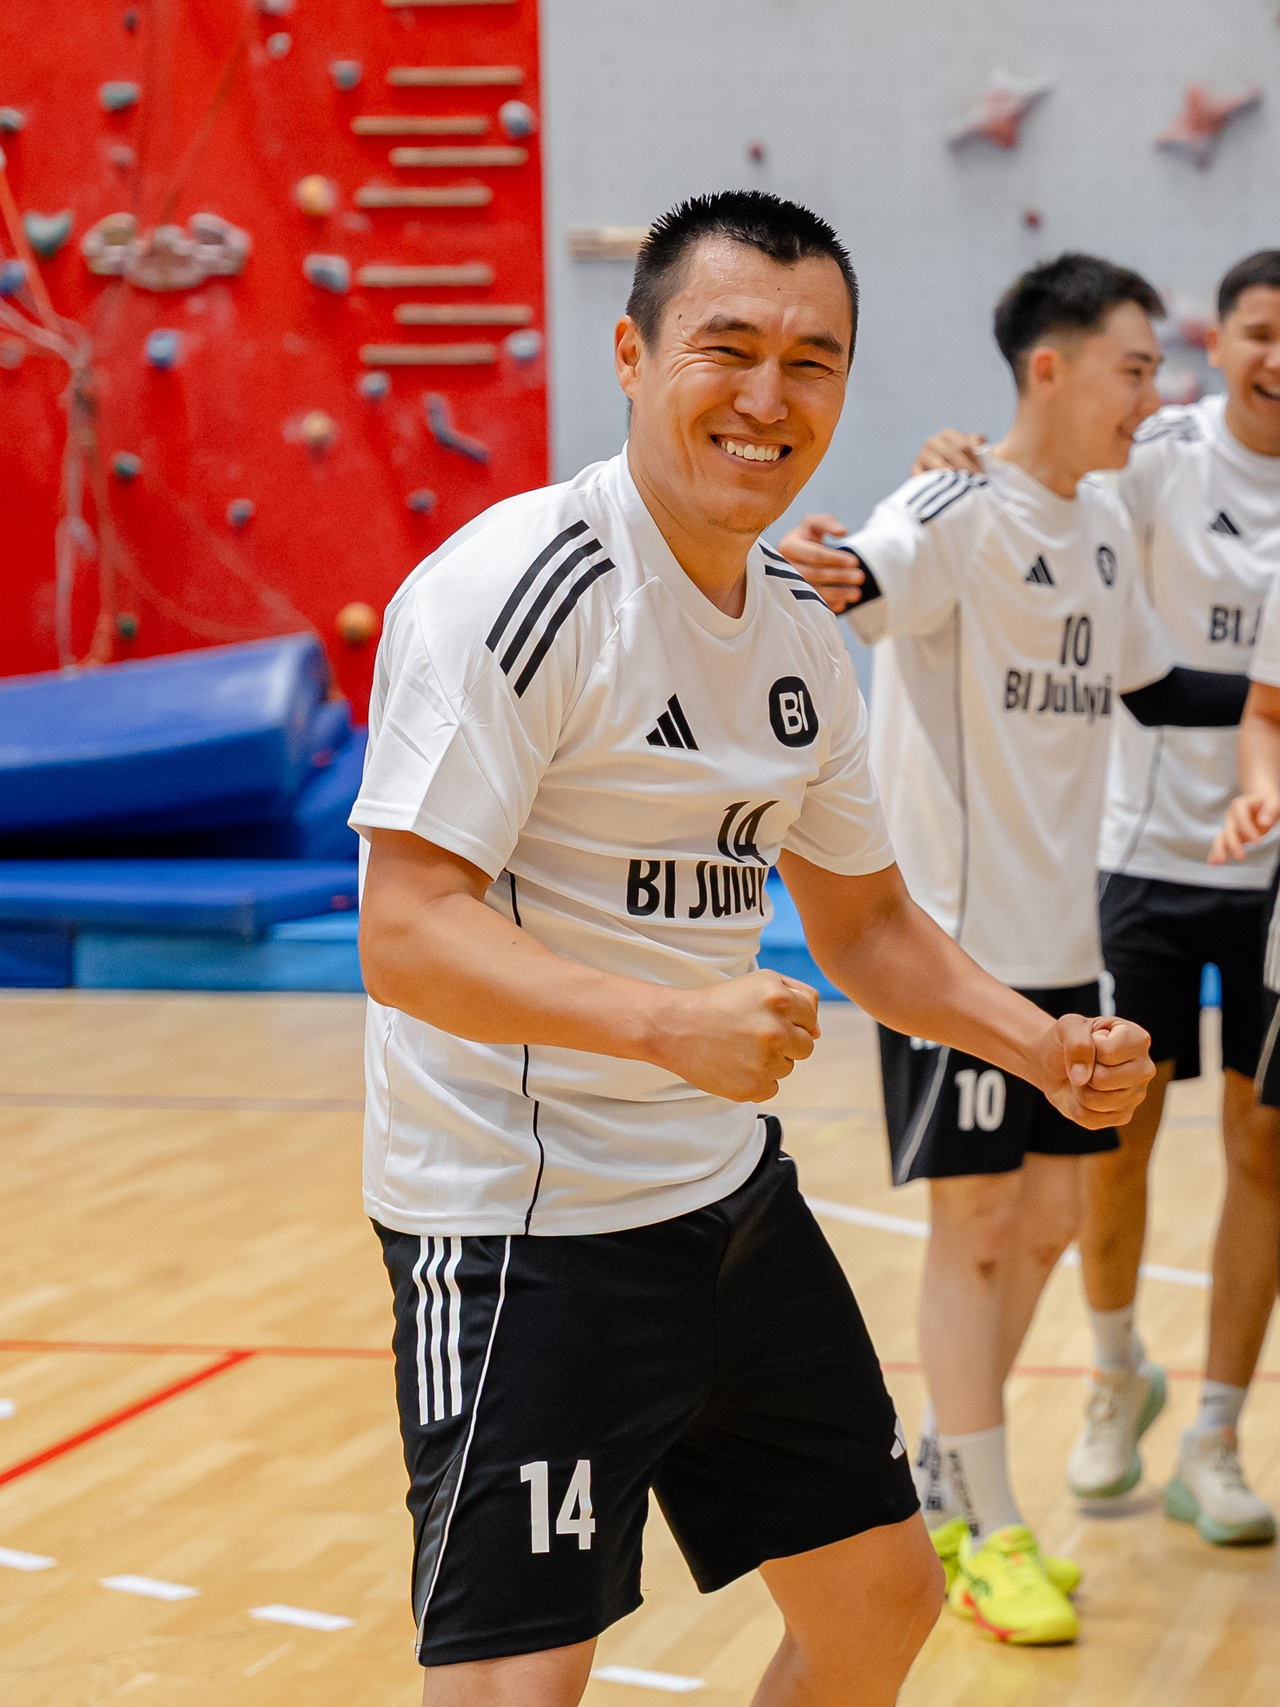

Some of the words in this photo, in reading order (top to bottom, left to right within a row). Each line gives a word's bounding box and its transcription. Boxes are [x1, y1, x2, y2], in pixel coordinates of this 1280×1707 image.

[1059, 615, 1093, 668] 10
[1209, 605, 1241, 644] BI
[778, 689, 809, 736] BI
[1004, 669, 1033, 711] BI
[716, 799, 781, 867] 14
[626, 858, 677, 919] BI
[954, 1068, 1007, 1132] 10
[519, 1459, 596, 1554] 14
